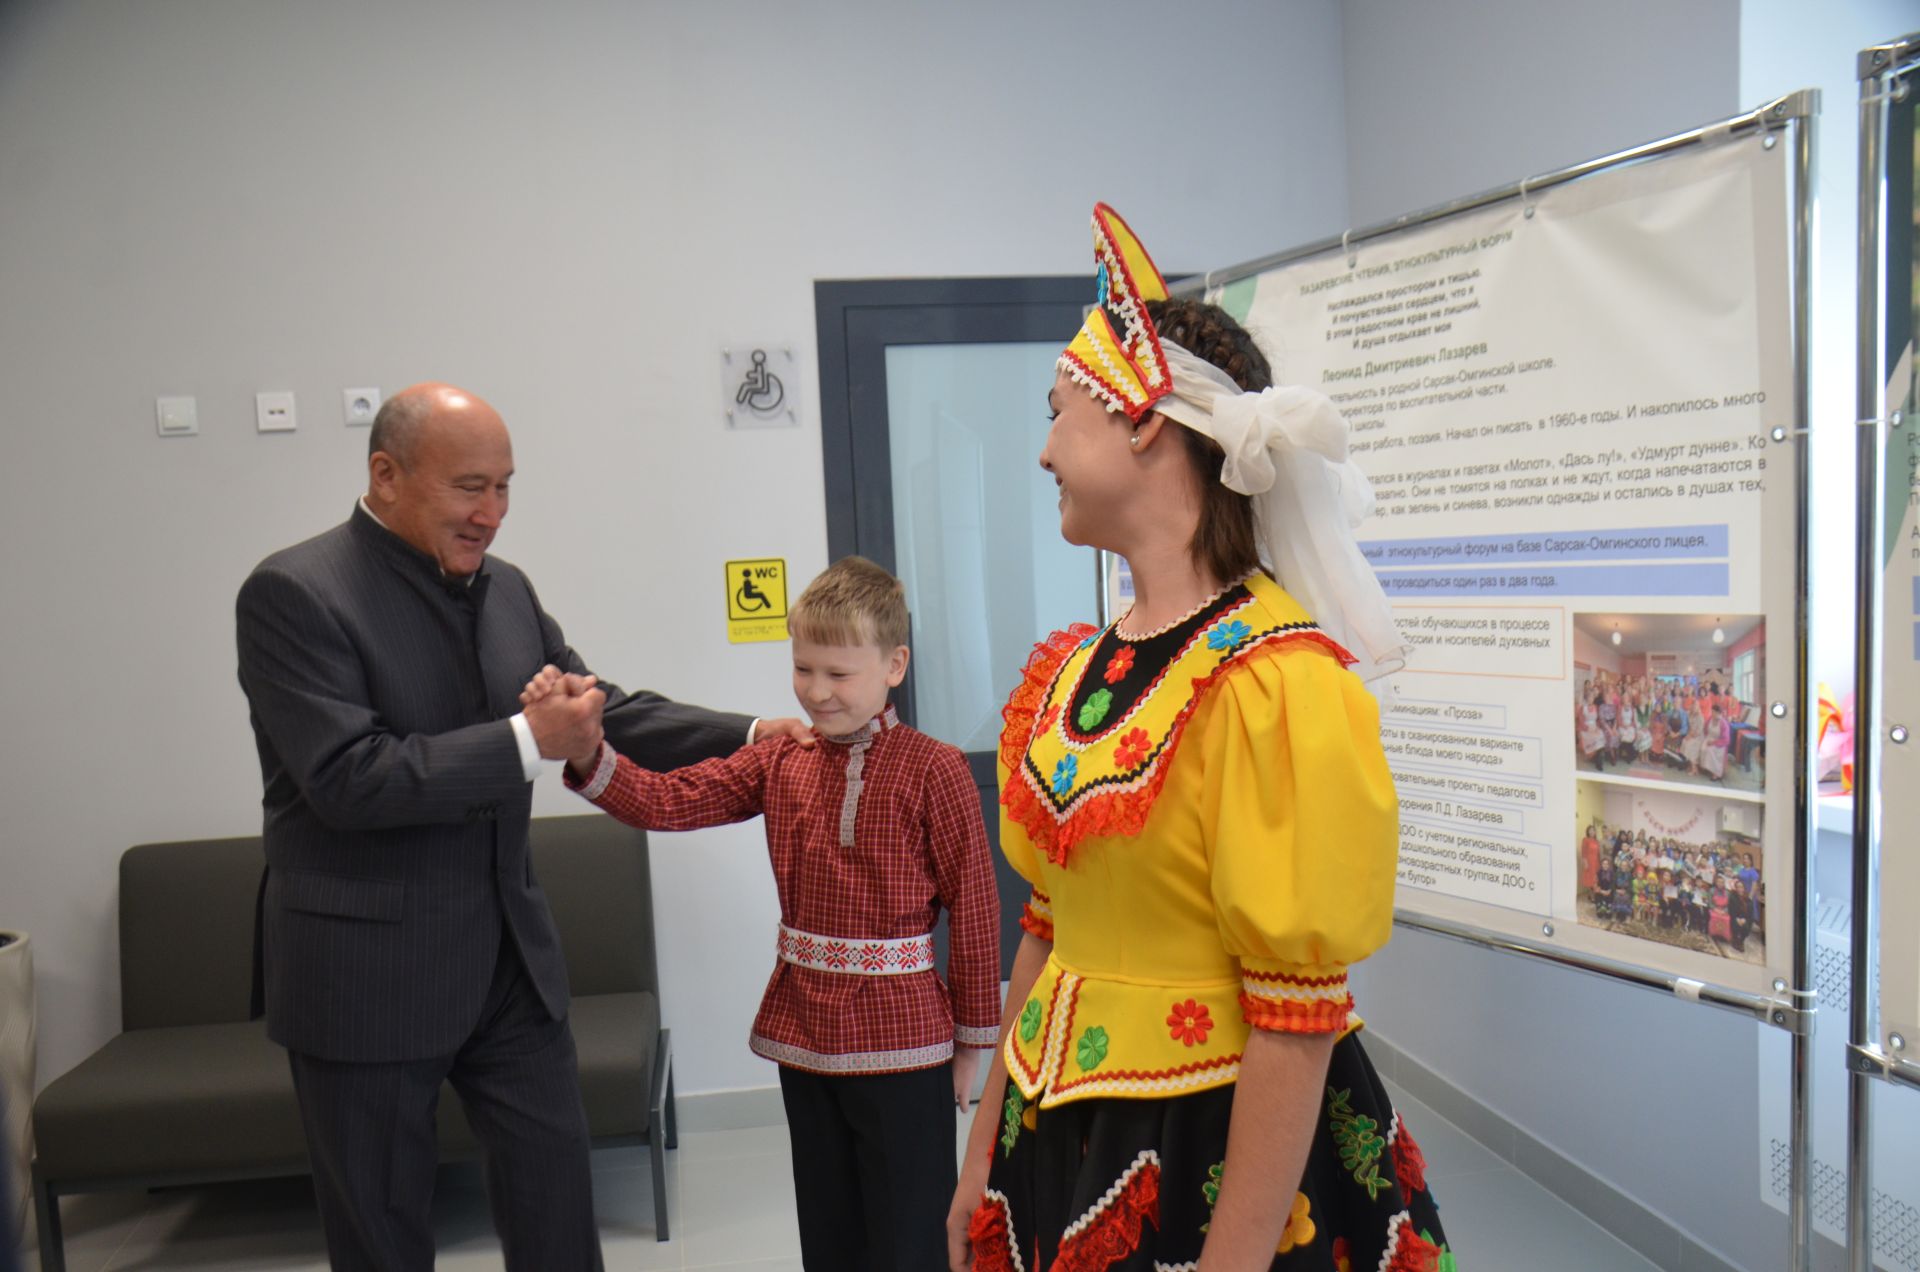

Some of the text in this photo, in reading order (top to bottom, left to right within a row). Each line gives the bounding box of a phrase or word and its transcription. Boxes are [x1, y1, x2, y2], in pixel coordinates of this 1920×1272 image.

[1394, 240, 1478, 273] ЭТНОКУЛЬТУРНЫЙ
[1480, 230, 1513, 250] ФОРУМ
[1385, 278, 1436, 300] простором
[1438, 276, 1446, 288] и
[1339, 302, 1403, 323] почувствовал
[1406, 292, 1449, 311] сердцем,
[1451, 287, 1467, 299] что
[1468, 285, 1475, 296] я
[1333, 326, 1353, 341] этом
[1354, 317, 1404, 338] радостном
[1406, 311, 1428, 327] крае
[1430, 308, 1441, 320] не
[1352, 338, 1360, 350] И
[1361, 335, 1386, 350] душа
[1388, 326, 1432, 344] отдыхает
[1321, 341, 1488, 384] Леонид Дмитриевич Лазарев
[1380, 386, 1387, 397] в
[1388, 377, 1421, 398] родной
[1423, 361, 1515, 390] Сарсак-Омгинской
[1518, 355, 1556, 374] школе.
[1386, 400, 1397, 412] по
[1399, 385, 1474, 409] воспитательной
[1475, 383, 1508, 398] части.
[1373, 435, 1406, 453] работа,
[1408, 430, 1442, 447] поэзия.
[1445, 423, 1478, 441] Начал
[1480, 425, 1495, 437] он
[1496, 419, 1533, 435] писать
[1538, 418, 1546, 430] в
[1549, 413, 1588, 429] 1960-е
[1591, 411, 1622, 425] годы.
[1627, 405, 1638, 419] И
[1640, 398, 1719, 418] накопилось
[1723, 391, 1767, 408] много
[1397, 472, 1404, 483] в
[1405, 464, 1451, 486] журналах
[1454, 465, 1461, 476] и
[1463, 461, 1501, 478] газетах
[1503, 457, 1555, 474] «Молот»,
[1559, 451, 1594, 468] «Дась
[1596, 450, 1627, 468] лу!»,
[1630, 443, 1685, 463] «Удмурт
[1688, 437, 1743, 457] дунне».
[1748, 434, 1767, 450] Ко
[1411, 484, 1432, 498] Они
[1434, 485, 1446, 496] не
[1449, 480, 1491, 495] томятся
[1493, 479, 1507, 491] на
[1510, 475, 1548, 489] полках
[1551, 474, 1559, 486] и
[1563, 472, 1578, 485] не
[1581, 468, 1613, 485] ждут,
[1617, 464, 1651, 481] когда
[1655, 457, 1752, 478] напечатаются
[1758, 457, 1766, 470] в
[1391, 503, 1406, 515] как
[1408, 501, 1441, 514] зелень
[1443, 501, 1450, 512] и
[1452, 498, 1491, 513] синева,
[1494, 493, 1543, 509] возникли
[1546, 489, 1601, 506] однажды
[1603, 489, 1611, 501] и
[1614, 485, 1674, 501] остались
[1676, 484, 1685, 497] в
[1688, 479, 1734, 498] душах
[1738, 478, 1767, 494] тех,
[1387, 542, 1462, 560] этнокультурный
[1464, 540, 1499, 558] форум
[1501, 543, 1514, 554] на
[1516, 538, 1541, 553] базе
[1544, 535, 1661, 555] Сарсак-Омгинского
[1664, 534, 1708, 549] лицея.
[754, 568, 778, 579] WC
[1392, 577, 1451, 590] проводиться
[1453, 577, 1478, 589] один
[1479, 575, 1497, 588] раз
[1499, 575, 1506, 587] в
[1508, 575, 1528, 588] два
[1530, 574, 1558, 588] года.
[1422, 616, 1488, 632] обучающихся
[1490, 618, 1498, 630] в
[1500, 618, 1550, 633] процессе
[1436, 634, 1443, 645] и
[1445, 634, 1497, 647] носителей
[1499, 634, 1550, 649] духовных
[1444, 706, 1483, 720] «Проза»
[1400, 730, 1406, 741] в
[1408, 731, 1477, 746] сканированном
[1480, 737, 1524, 752] варианте
[1405, 743, 1434, 757] блюда
[1436, 749, 1463, 761] моего
[1465, 752, 1503, 766] народа»
[1448, 779, 1485, 792] проекты
[1487, 784, 1537, 801] педагогов
[1435, 801, 1453, 817] Л.Д.
[1456, 805, 1503, 824] Лазарева
[1401, 840, 1457, 860] дошкольного
[1418, 828, 1424, 838] с
[1425, 830, 1455, 844] учетом
[1457, 836, 1528, 859] региональных,
[1408, 869, 1437, 886] бугор»
[1463, 868, 1501, 887] группах
[1502, 873, 1527, 890] ДОО
[1528, 880, 1535, 891] с
